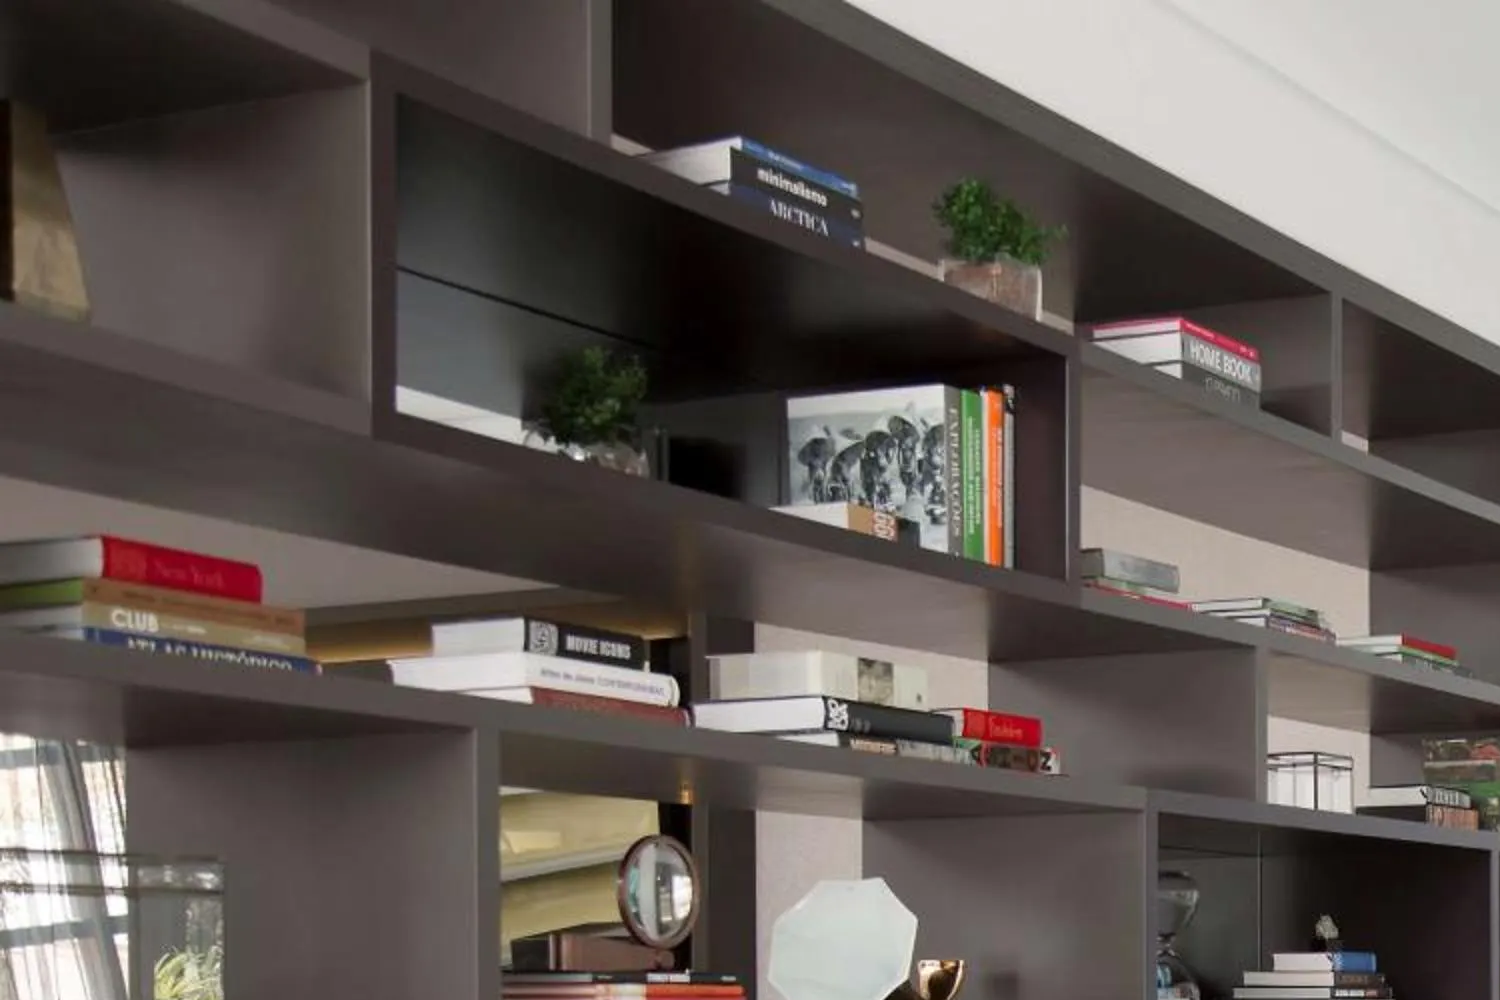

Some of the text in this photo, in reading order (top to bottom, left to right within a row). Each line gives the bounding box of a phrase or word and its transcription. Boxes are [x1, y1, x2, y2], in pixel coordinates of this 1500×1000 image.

[1190, 338, 1253, 384] HOME BOOK
[111, 608, 158, 633] CLUB
[565, 633, 599, 655] MOVIE
